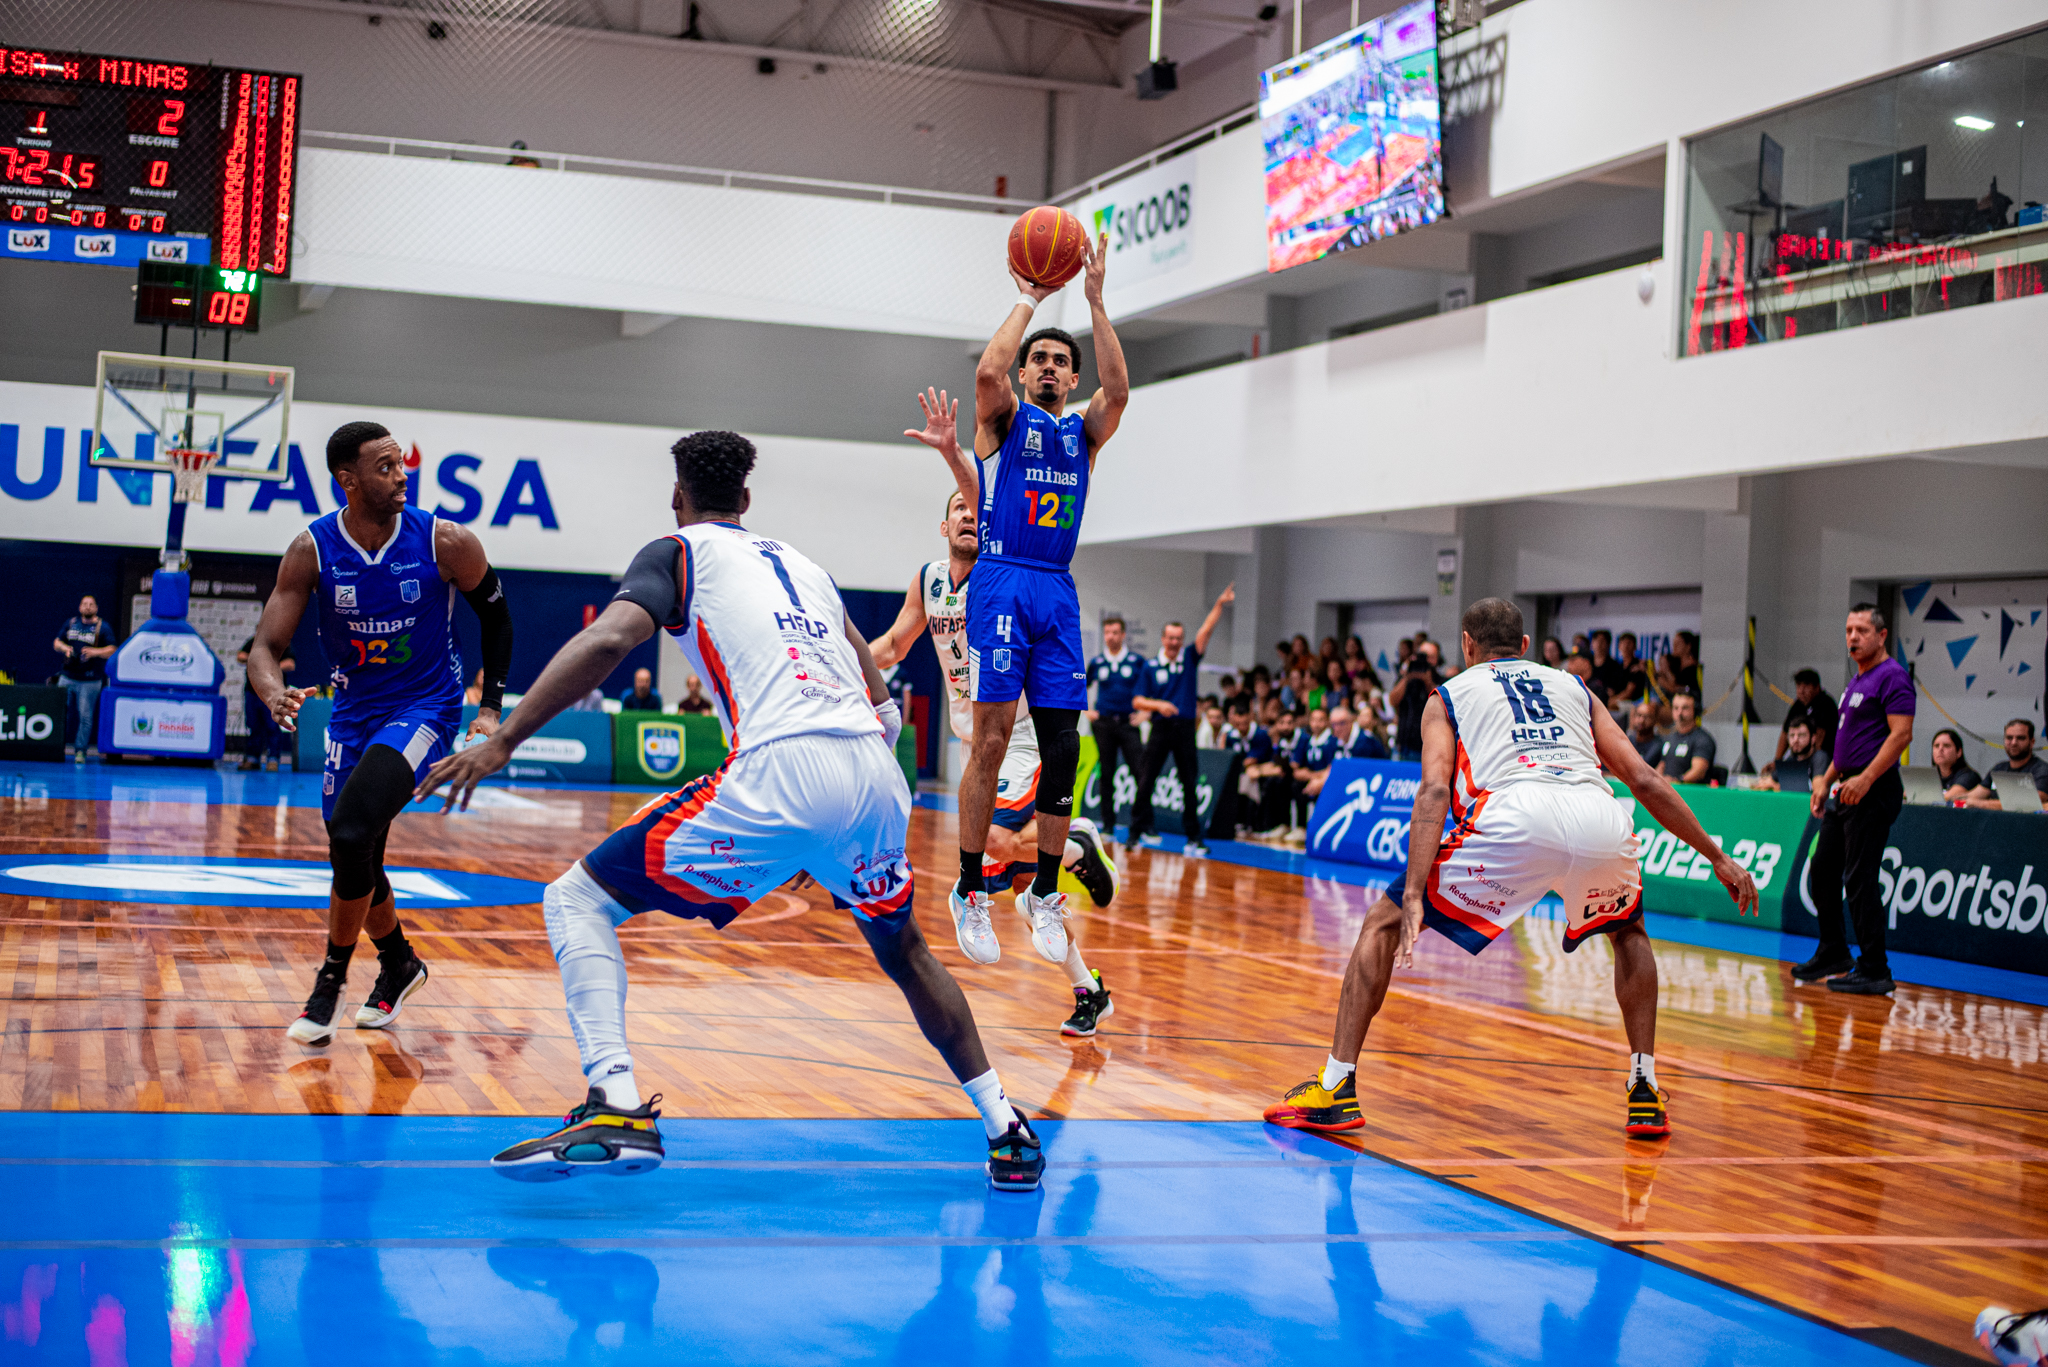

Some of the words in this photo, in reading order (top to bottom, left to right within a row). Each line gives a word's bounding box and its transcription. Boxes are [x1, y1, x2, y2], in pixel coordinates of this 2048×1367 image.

[99, 59, 189, 91] MINAS
[35, 111, 47, 135] 1
[158, 100, 186, 136] 2
[128, 134, 180, 149] ESCORE
[149, 160, 169, 187] 0
[11, 205, 24, 221] 0
[35, 207, 48, 224] 0
[70, 210, 83, 227] 0
[93, 211, 106, 228] 0
[129, 214, 142, 231] 0
[152, 216, 165, 233] 0
[1115, 183, 1190, 252] SICOOB
[208, 291, 251, 325] 08
[1025, 466, 1078, 487] minas
[1025, 490, 1076, 529] 123
[759, 549, 806, 614] 1
[347, 616, 416, 634] minas
[774, 612, 830, 640] HELP
[996, 614, 1013, 643] 4
[350, 634, 413, 666] 123
[950, 638, 963, 660] 8
[1491, 678, 1557, 724] 18
[1511, 725, 1565, 743] HELP
[850, 861, 904, 899] LUX
[1448, 884, 1503, 916] Redepharma
[1583, 891, 1630, 920] LUX
